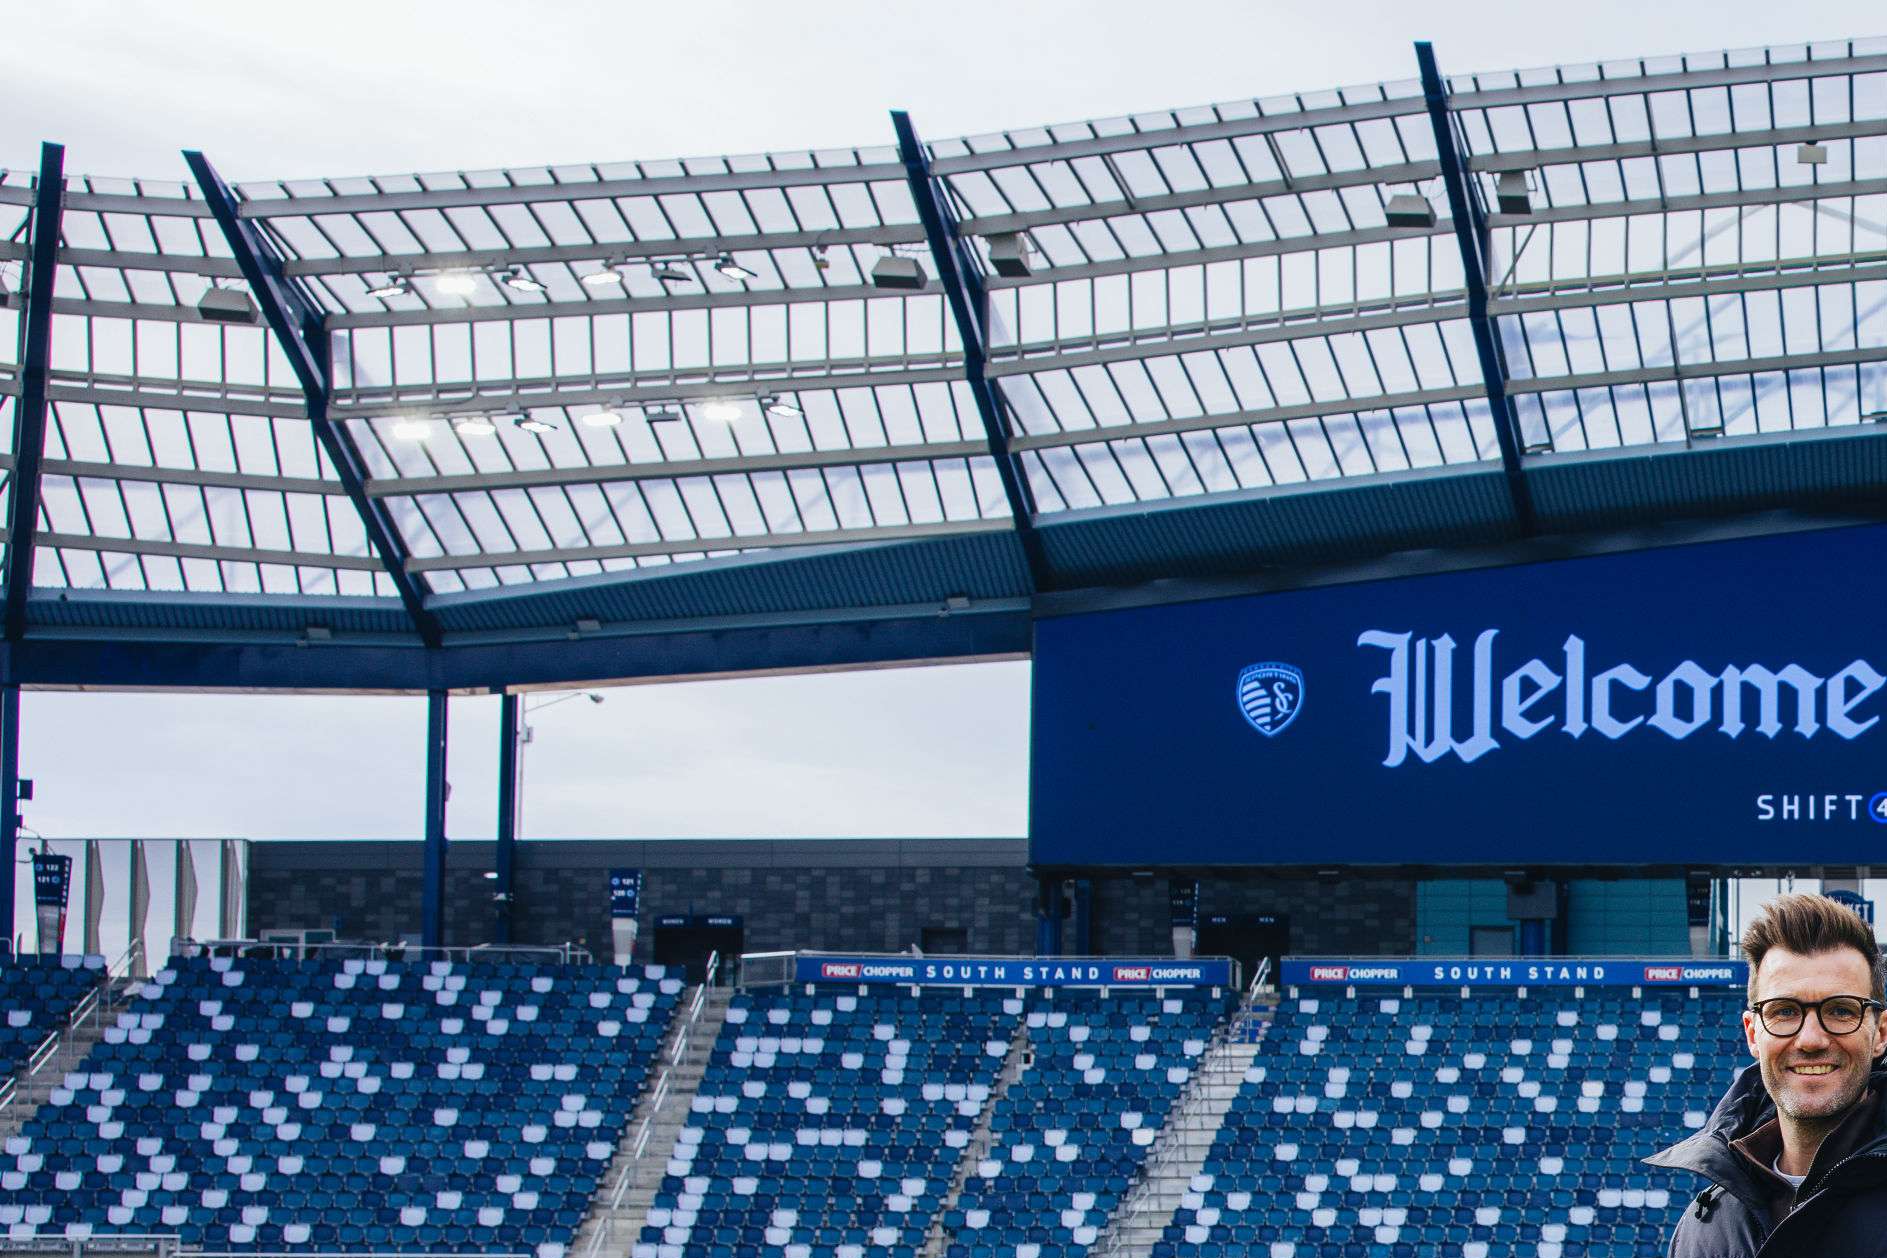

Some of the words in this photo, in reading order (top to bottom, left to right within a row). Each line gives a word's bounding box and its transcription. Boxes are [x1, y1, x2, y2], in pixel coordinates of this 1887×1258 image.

[1356, 628, 1887, 768] Welcome
[825, 965, 858, 977] PRICE
[863, 966, 914, 978] CHOPPER
[926, 965, 1006, 980] SOUTH
[1022, 965, 1100, 981] STAND
[1116, 968, 1148, 980] PRICE
[1152, 968, 1201, 980] CHOPPER
[1313, 967, 1345, 980] PRICE
[1349, 968, 1398, 980] CHOPPER
[1433, 966, 1512, 981] SOUTH
[1528, 966, 1605, 981] STAND
[1647, 968, 1679, 980] PRICE
[1683, 968, 1732, 980] CHOPPER
